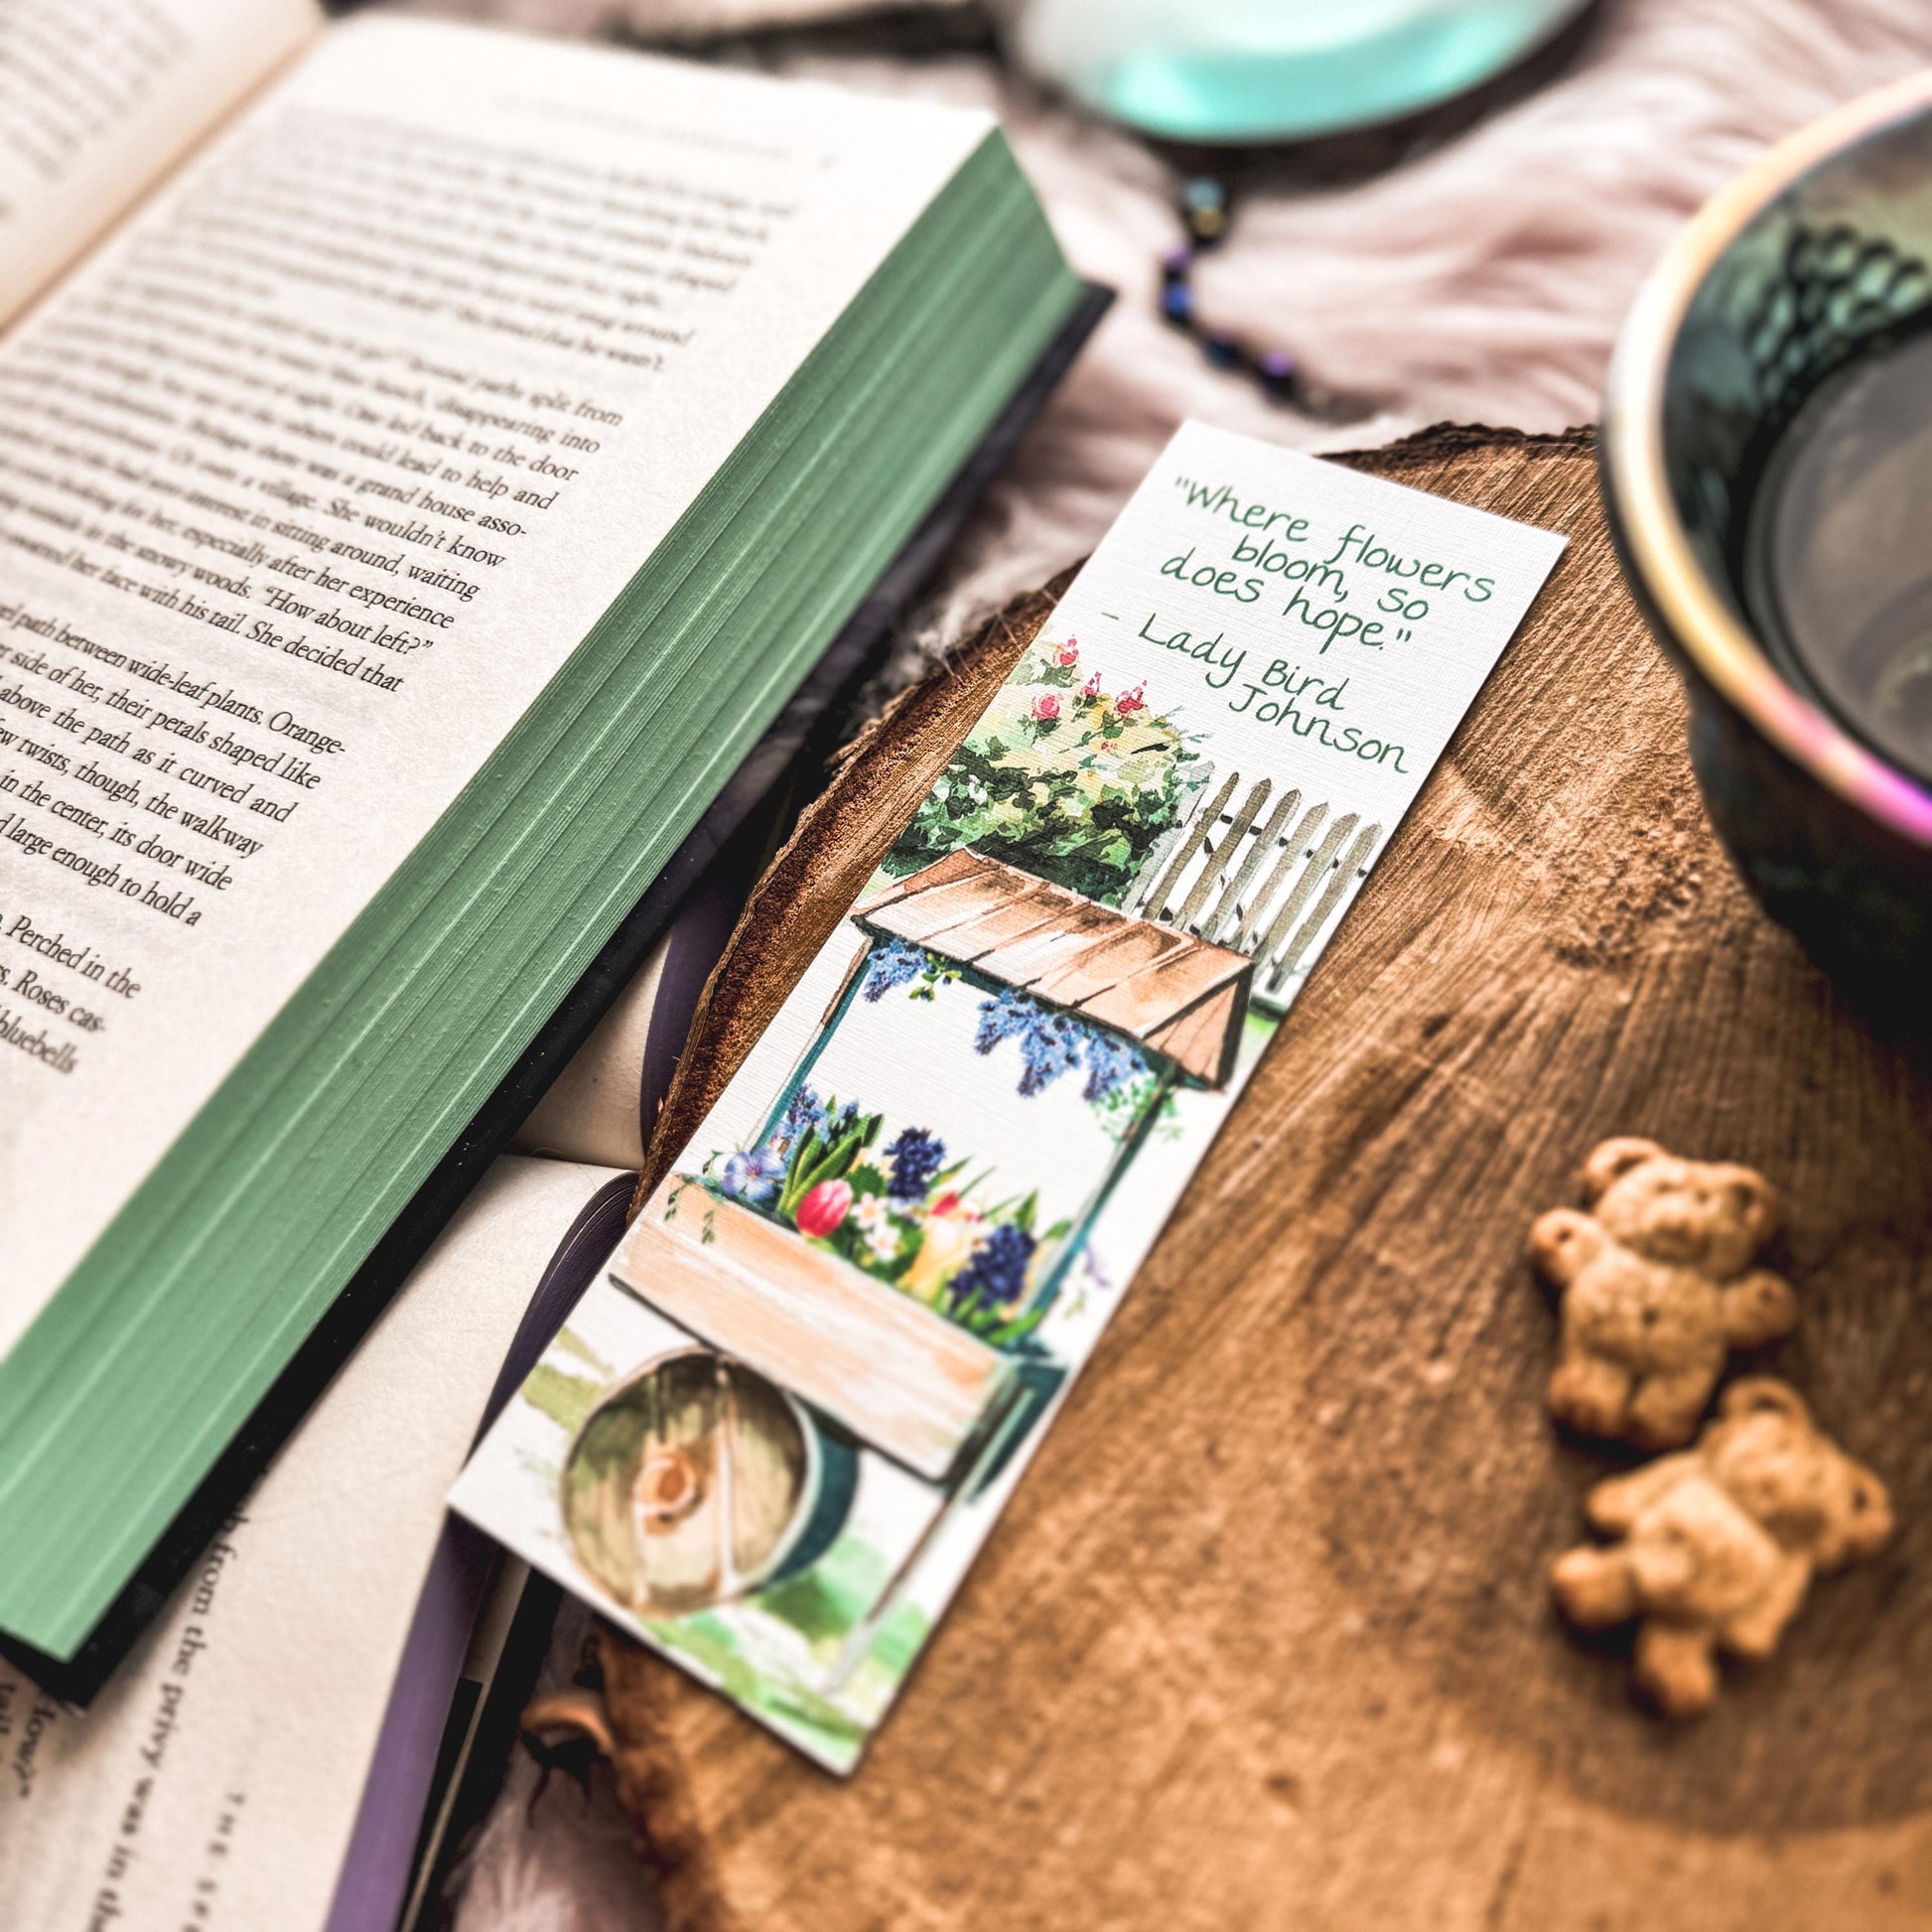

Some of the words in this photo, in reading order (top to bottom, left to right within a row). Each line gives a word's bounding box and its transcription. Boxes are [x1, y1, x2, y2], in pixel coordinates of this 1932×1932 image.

[418, 423, 464, 450] back
[469, 439, 489, 457] to
[492, 446, 527, 469] the
[529, 455, 580, 483] door
[435, 397, 556, 445] disappearing
[560, 429, 601, 454] into
[574, 398, 623, 428] from
[355, 477, 420, 505] grand
[417, 487, 477, 522] house
[478, 512, 528, 537] asso-
[395, 450, 443, 477] lead
[441, 467, 463, 483] to
[465, 471, 510, 500] help
[513, 489, 561, 511] and
[249, 510, 272, 529] in
[272, 518, 331, 554] sitting
[331, 540, 406, 578] around,
[407, 563, 482, 604] waiting
[324, 496, 361, 522] She
[363, 518, 447, 550] wouldn’t
[446, 534, 508, 568] know
[1174, 476, 1310, 542] "Where
[1323, 523, 1496, 604] flowers
[69, 550, 102, 578] her
[100, 566, 140, 594] face
[137, 582, 181, 610] with
[178, 595, 210, 621] his
[208, 611, 248, 635] tail.
[246, 620, 285, 649] She
[282, 633, 367, 678] decided
[359, 663, 405, 693] that
[135, 546, 193, 578] snowy
[193, 567, 252, 600] woods.
[265, 584, 317, 620] “How
[315, 608, 373, 641] about
[371, 624, 434, 656] left?”
[182, 525, 270, 569] especially
[268, 554, 317, 583] after
[314, 566, 349, 594] her
[348, 584, 456, 630] experience
[1161, 546, 1266, 604] does
[1283, 586, 1413, 655] hope."
[1232, 534, 1349, 604] bloom,
[1376, 586, 1430, 621] so
[11, 613, 58, 638] path
[55, 622, 129, 669] between
[127, 659, 217, 701] wide-leaf
[199, 688, 263, 726] plants.
[268, 711, 346, 756] Orange-
[1138, 613, 1248, 690] Lady
[1261, 658, 1351, 712] Bird
[0, 684, 52, 720] above
[53, 708, 86, 735] the
[81, 726, 132, 755] path
[131, 747, 158, 765] as
[157, 752, 179, 774] it
[179, 764, 255, 805] curved
[249, 796, 300, 823] and
[10, 648, 49, 676] side
[49, 666, 80, 685] of
[68, 669, 104, 705] her,
[105, 688, 153, 721] their
[145, 711, 210, 745] petals
[207, 732, 286, 774] shaped
[278, 757, 322, 790] like
[1228, 684, 1410, 775] Johnson
[0, 768, 21, 794] in
[19, 780, 52, 808] the
[51, 799, 109, 840] center,
[109, 821, 138, 848] its
[136, 834, 185, 869] door
[184, 859, 234, 892] wide
[17, 738, 71, 776] twists,
[74, 760, 142, 809] though,
[145, 791, 180, 821] the
[180, 811, 265, 860] walkway
[5, 817, 54, 857] large
[52, 847, 122, 888] enough
[119, 877, 143, 897] to
[139, 880, 196, 919] hold
[185, 910, 204, 927] a
[5, 914, 92, 970] Perched
[80, 953, 106, 982] in
[104, 967, 142, 999] the
[11, 968, 71, 1016] Roses
[68, 1007, 107, 1034] cas-
[0, 1009, 78, 1075] bluebells
[192, 1540, 238, 1616] from
[170, 1623, 209, 1677] the
[138, 1680, 184, 1770] privy
[120, 1776, 155, 1837] was
[105, 1844, 135, 1882] in
